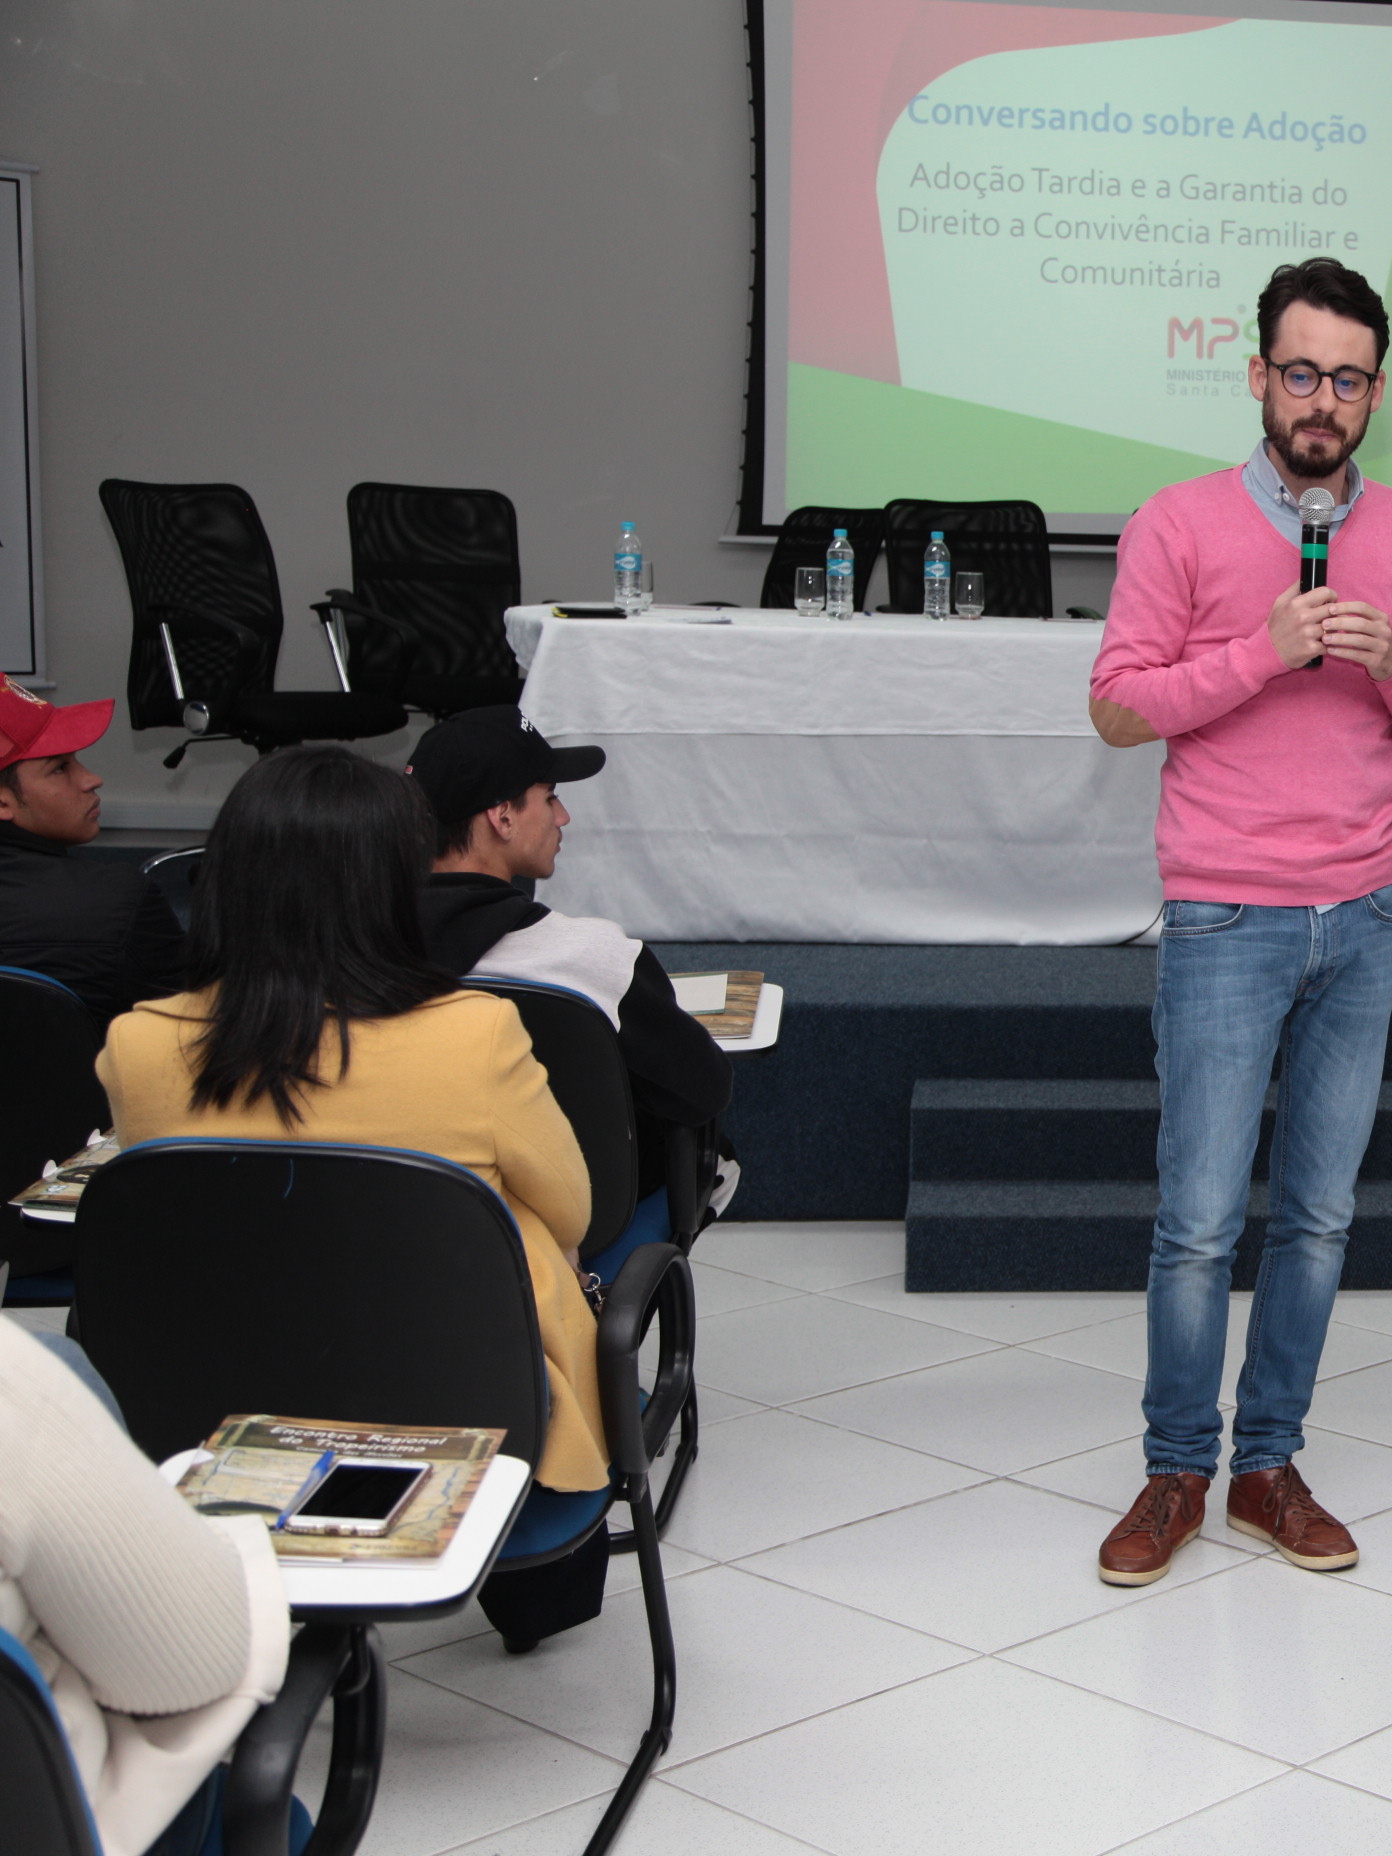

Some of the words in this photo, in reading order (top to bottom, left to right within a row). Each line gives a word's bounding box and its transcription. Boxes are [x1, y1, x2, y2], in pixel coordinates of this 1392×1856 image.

[907, 94, 1133, 134] Conversando
[1142, 106, 1235, 139] sobre
[1242, 111, 1367, 151] Adoção
[909, 162, 1025, 199] Adoção
[1030, 167, 1121, 197] Tardia
[1131, 178, 1147, 198] e
[1156, 179, 1171, 199] a
[1179, 174, 1303, 204] Garantia
[1312, 178, 1348, 206] do
[897, 206, 1000, 237] Direito
[1009, 218, 1025, 237] a
[1034, 212, 1210, 244] Convivência
[1220, 219, 1336, 249] Familiar
[1343, 230, 1359, 250] e
[1039, 257, 1221, 289] Comunitária
[1166, 367, 1246, 382] MINISTÉRIO
[1166, 384, 1220, 397] Santa
[270, 1426, 358, 1441] Encontro
[366, 1434, 449, 1446] Regional
